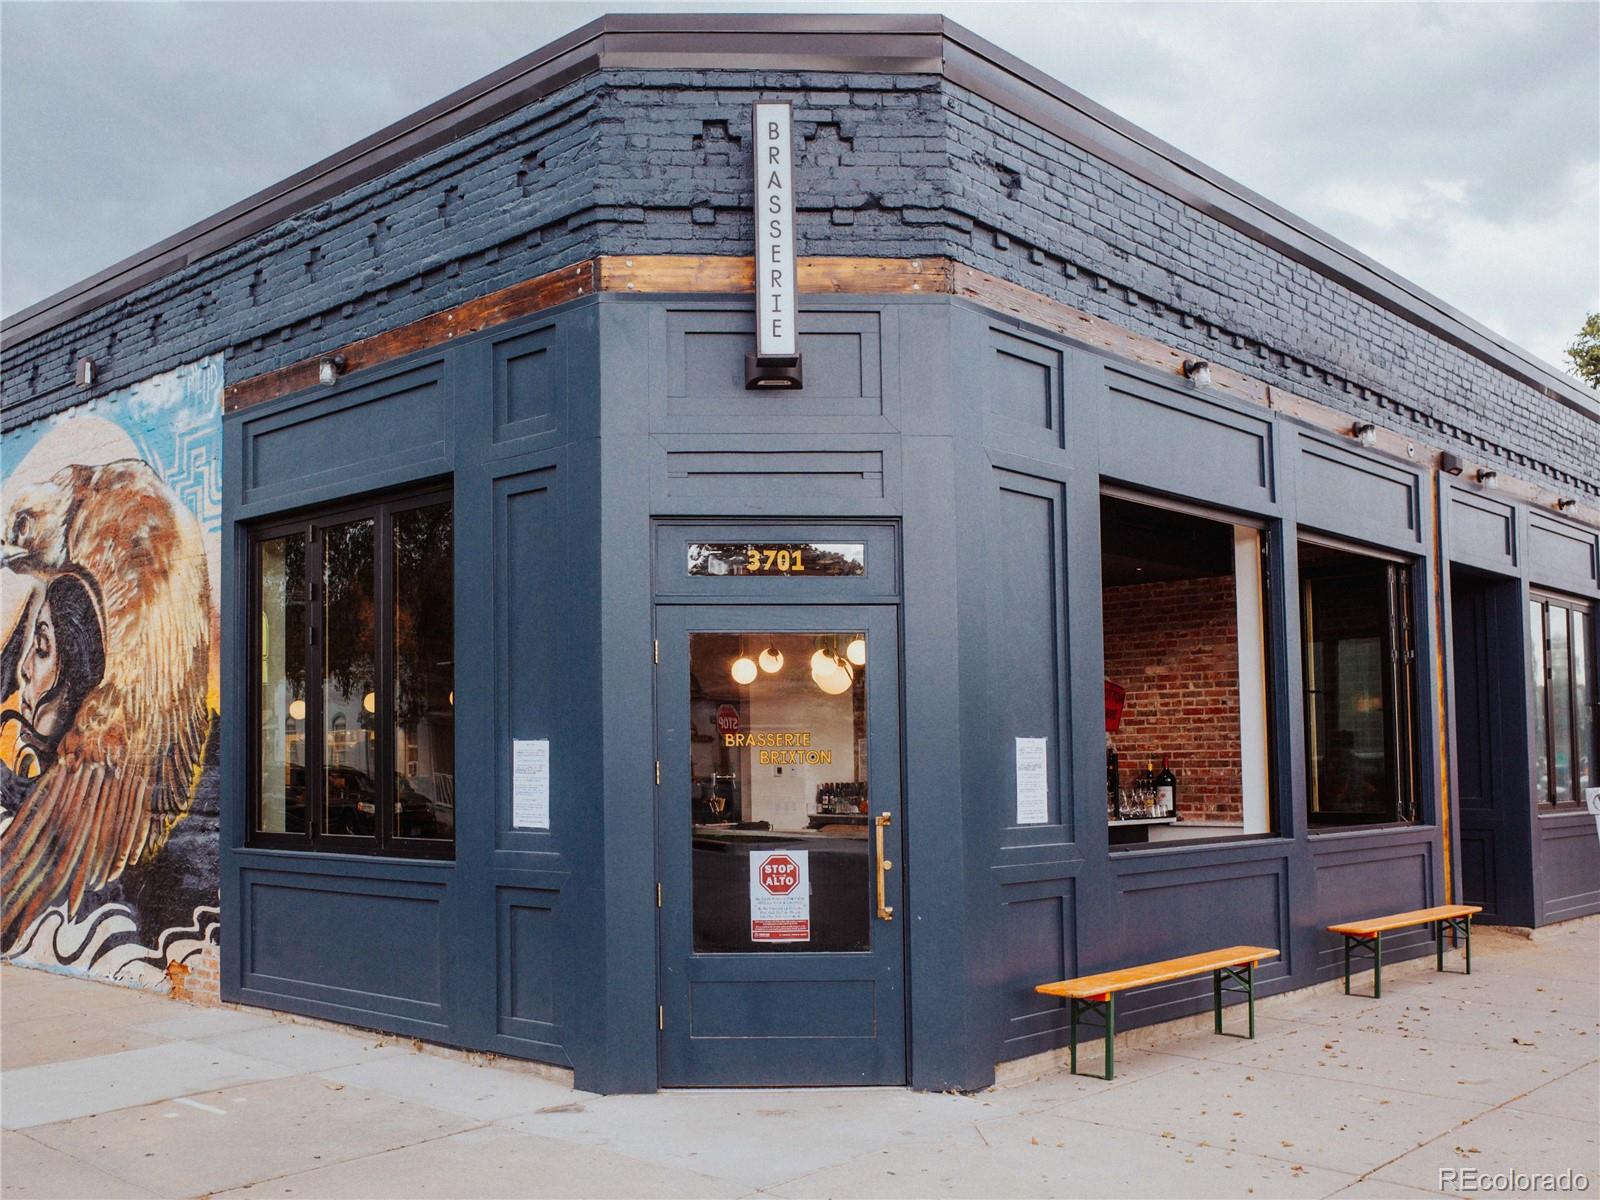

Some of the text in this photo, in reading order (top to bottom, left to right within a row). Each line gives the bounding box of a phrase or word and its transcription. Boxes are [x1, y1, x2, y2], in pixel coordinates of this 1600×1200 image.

[767, 121, 782, 338] BRASSERIE
[746, 549, 805, 571] 3701
[725, 733, 811, 747] BRASSERIE
[759, 750, 832, 764] BRIXTON
[764, 864, 795, 874] STOP
[765, 877, 794, 886] ALTO
